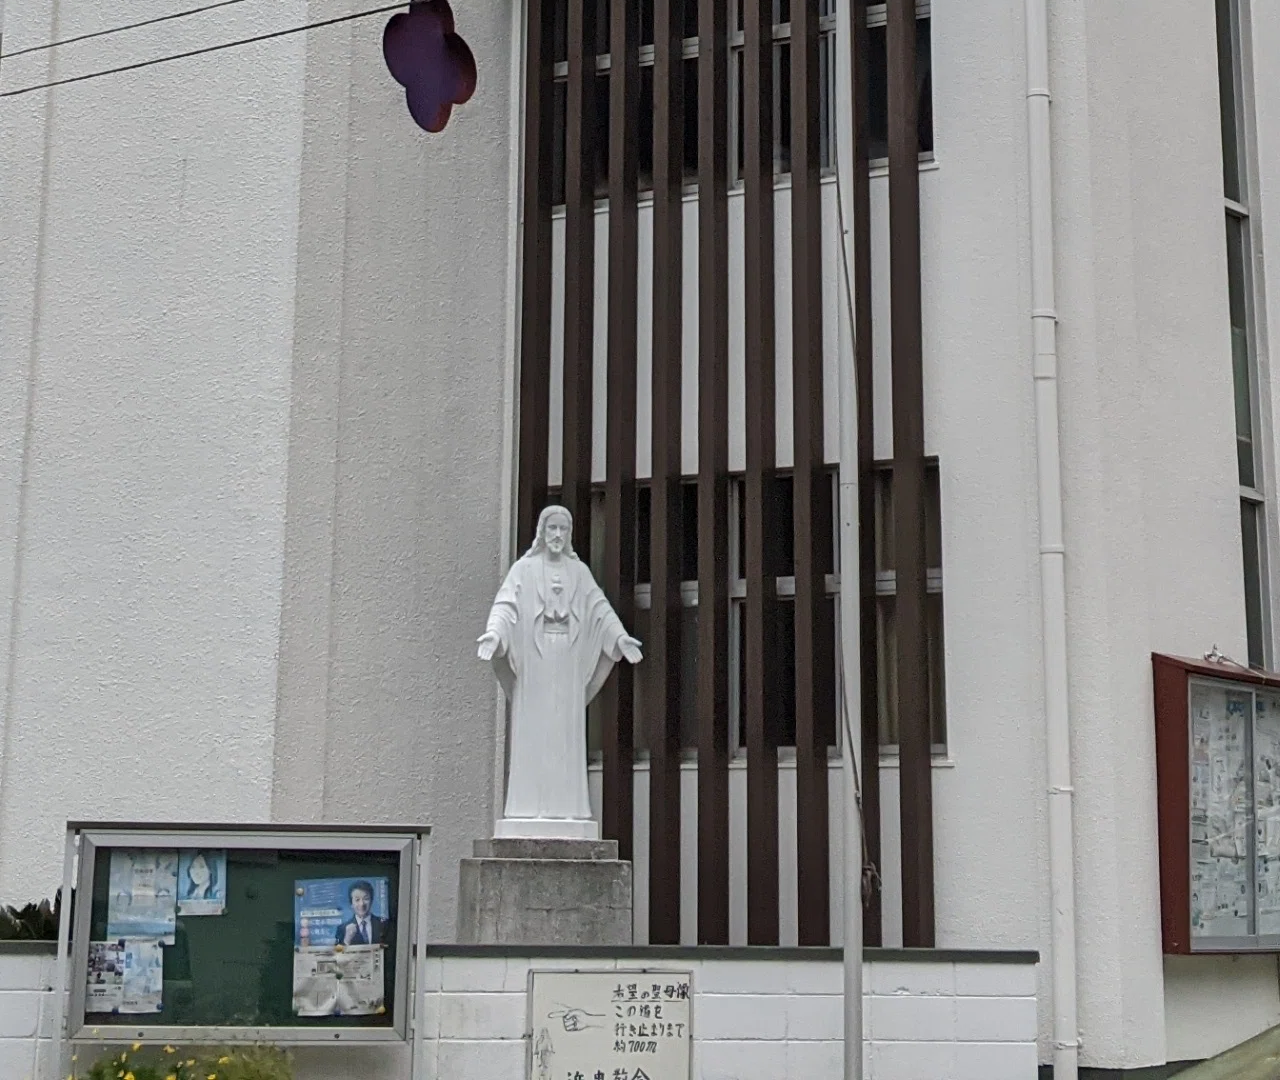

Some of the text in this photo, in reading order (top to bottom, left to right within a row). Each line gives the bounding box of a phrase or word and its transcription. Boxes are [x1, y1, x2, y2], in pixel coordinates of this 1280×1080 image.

[614, 1022, 685, 1038] 行き止まりまで
